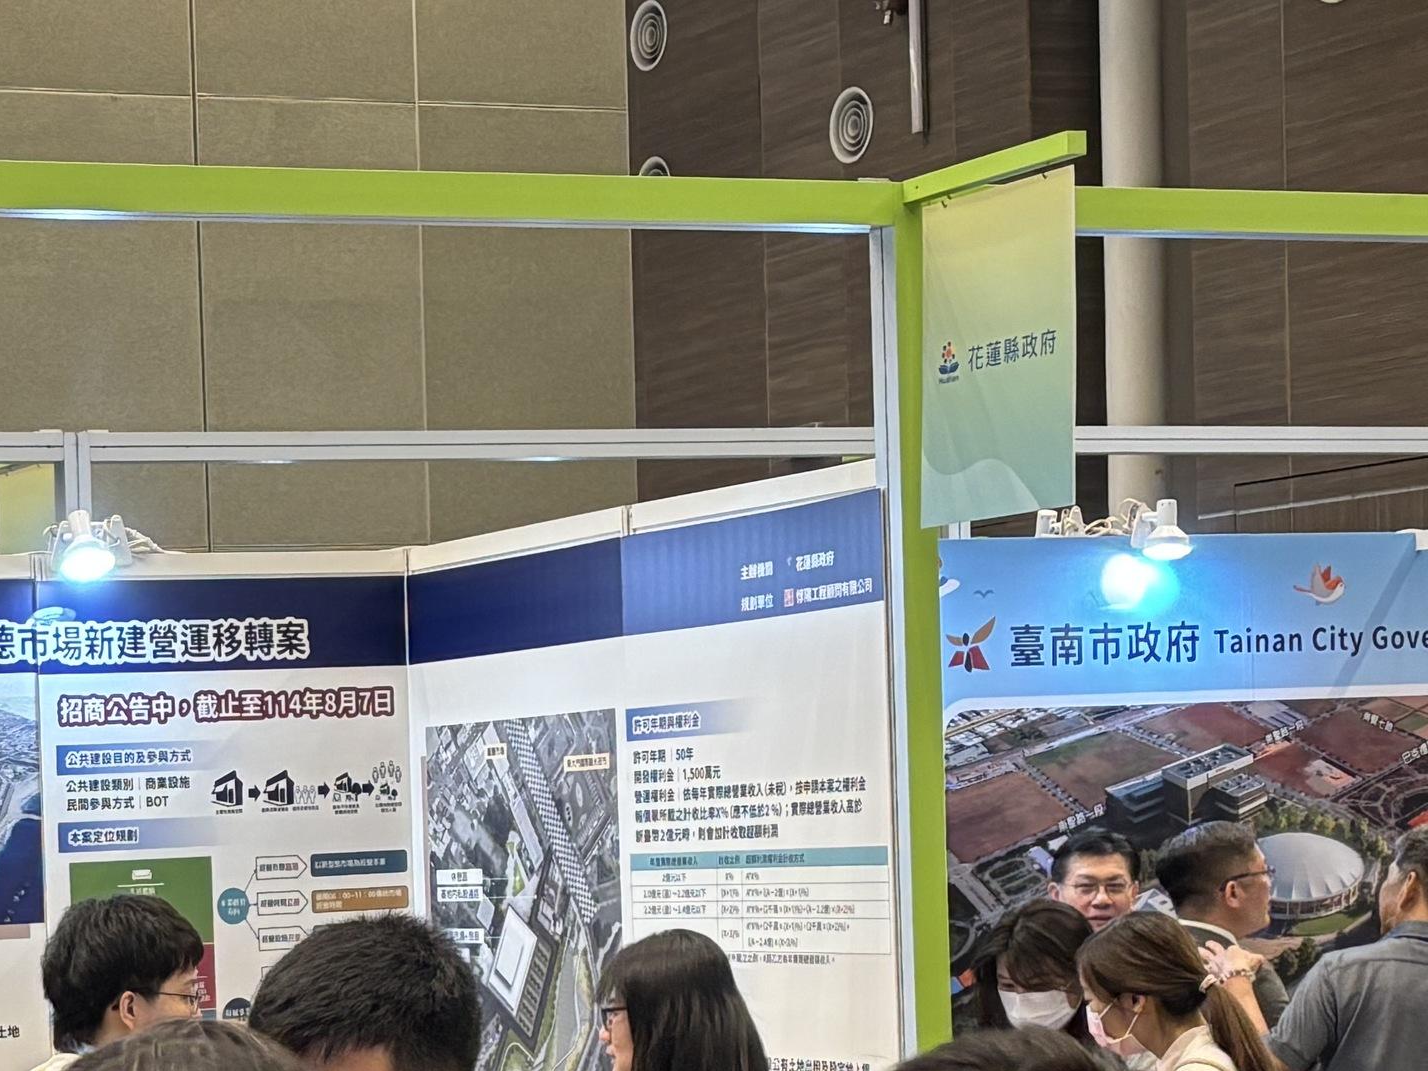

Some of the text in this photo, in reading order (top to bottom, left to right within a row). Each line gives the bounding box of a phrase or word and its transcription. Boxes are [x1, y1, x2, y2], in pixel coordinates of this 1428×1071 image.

[968, 328, 1057, 372] 花蓮縣政府
[1009, 620, 1200, 667] 臺南市政府
[1214, 627, 1303, 654] Tainan
[1312, 625, 1363, 656] City
[59, 686, 395, 727] 招商公告中，截止至114年8月7日
[65, 748, 192, 767] 公共建設目的及參與方式
[676, 747, 694, 761] 50年
[66, 776, 190, 793] 公共建設類別 商業設施
[66, 795, 169, 811] 民間參與方式 BOT
[69, 828, 138, 845] 本案定位規劃
